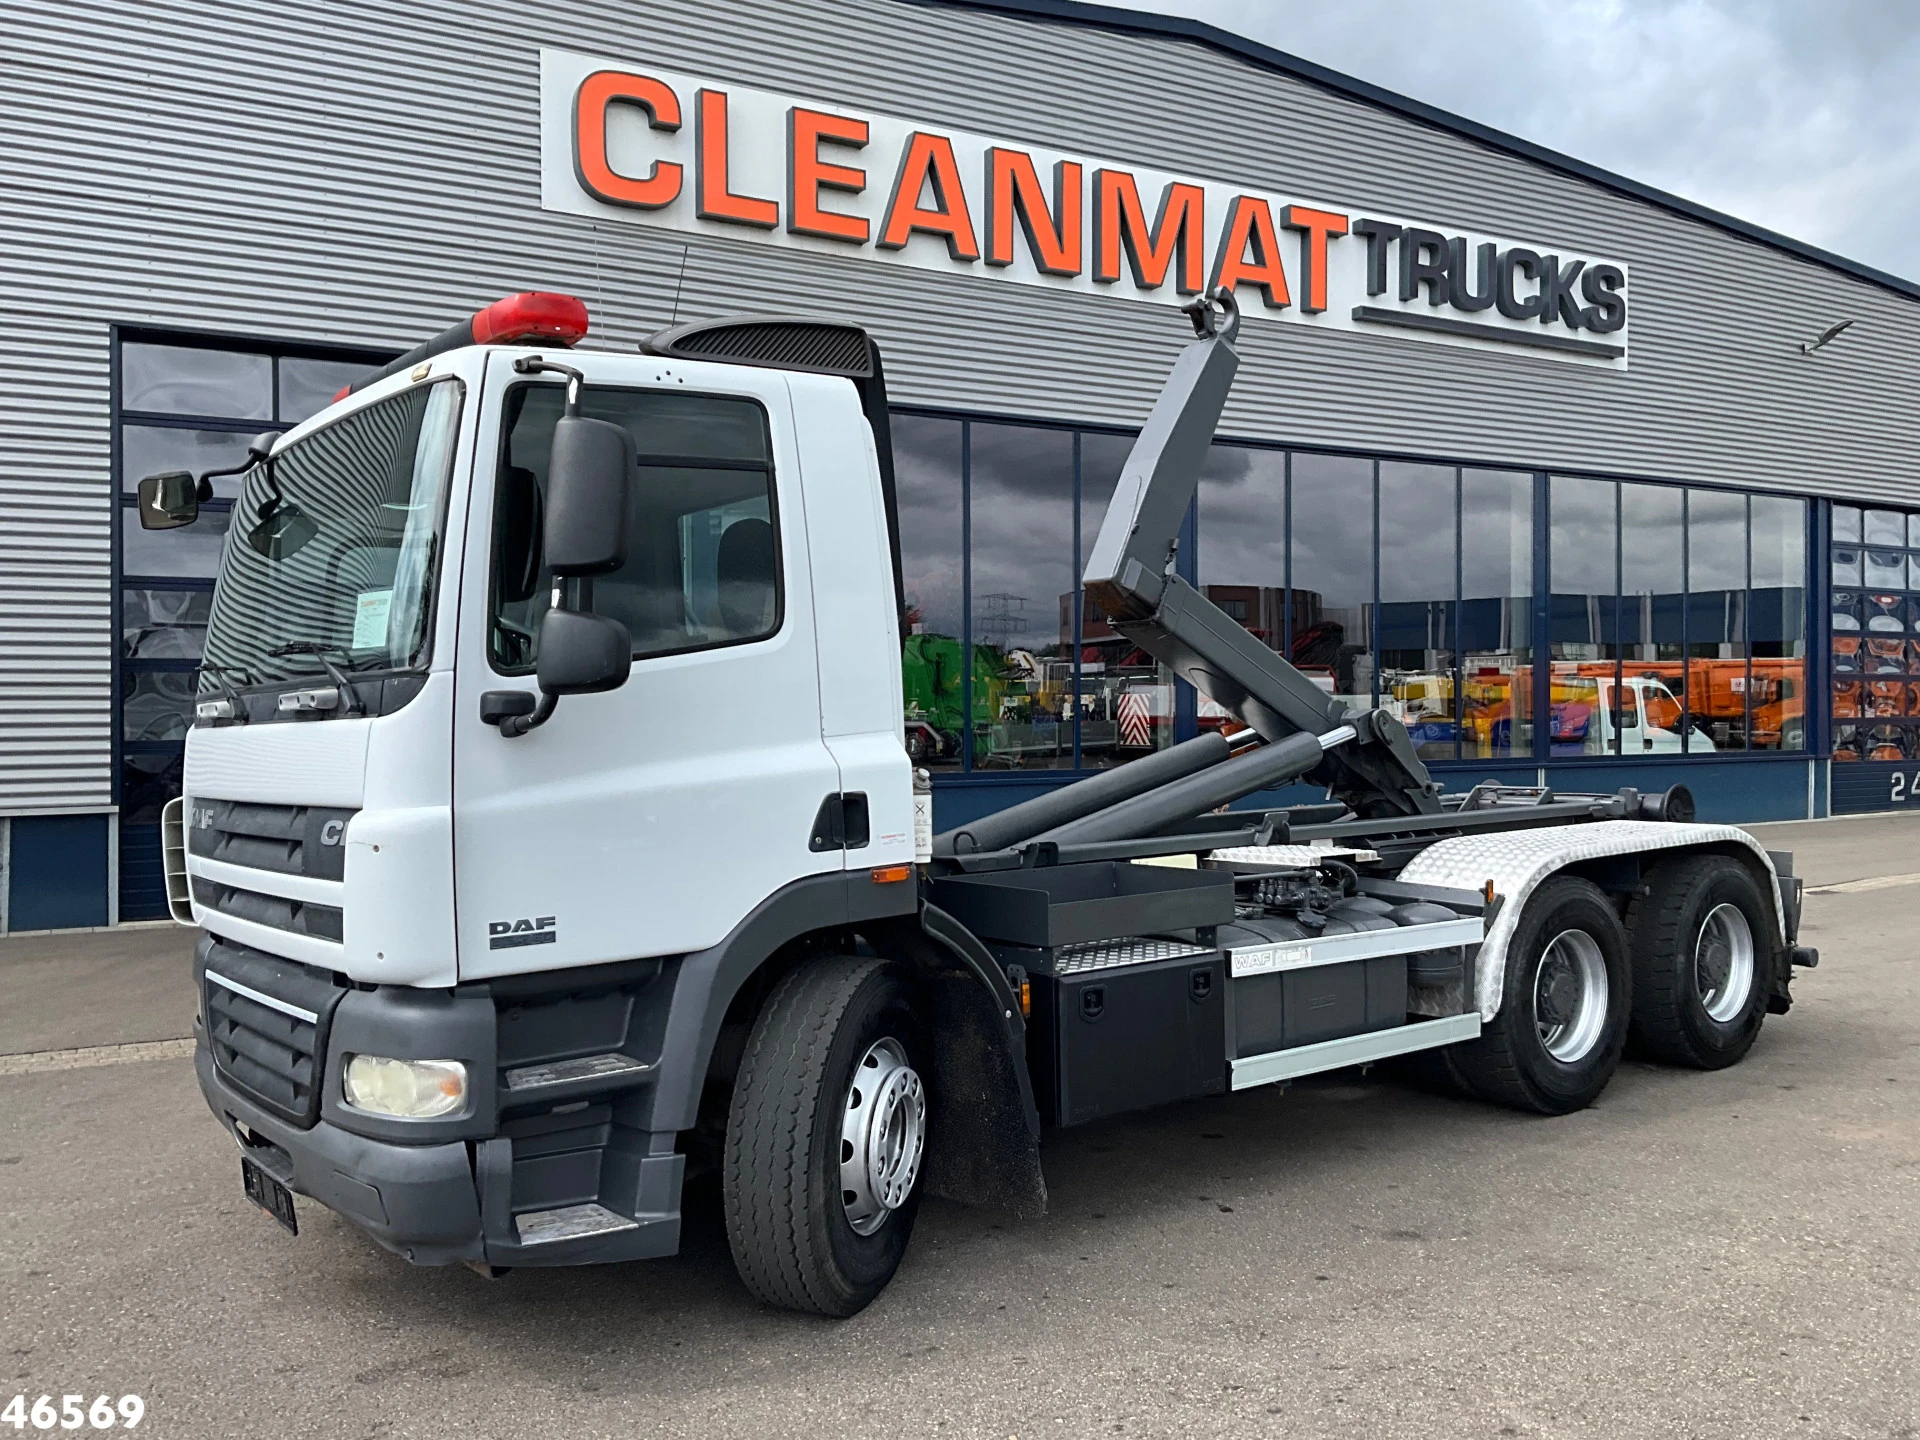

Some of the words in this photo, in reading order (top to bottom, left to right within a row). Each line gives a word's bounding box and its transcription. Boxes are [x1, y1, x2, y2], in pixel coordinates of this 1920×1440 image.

[571, 69, 1349, 314] CLEANMAT
[1352, 217, 1626, 334] TRUCKS
[320, 819, 349, 846] C
[489, 916, 556, 935] DAF
[1234, 952, 1271, 969] WAF
